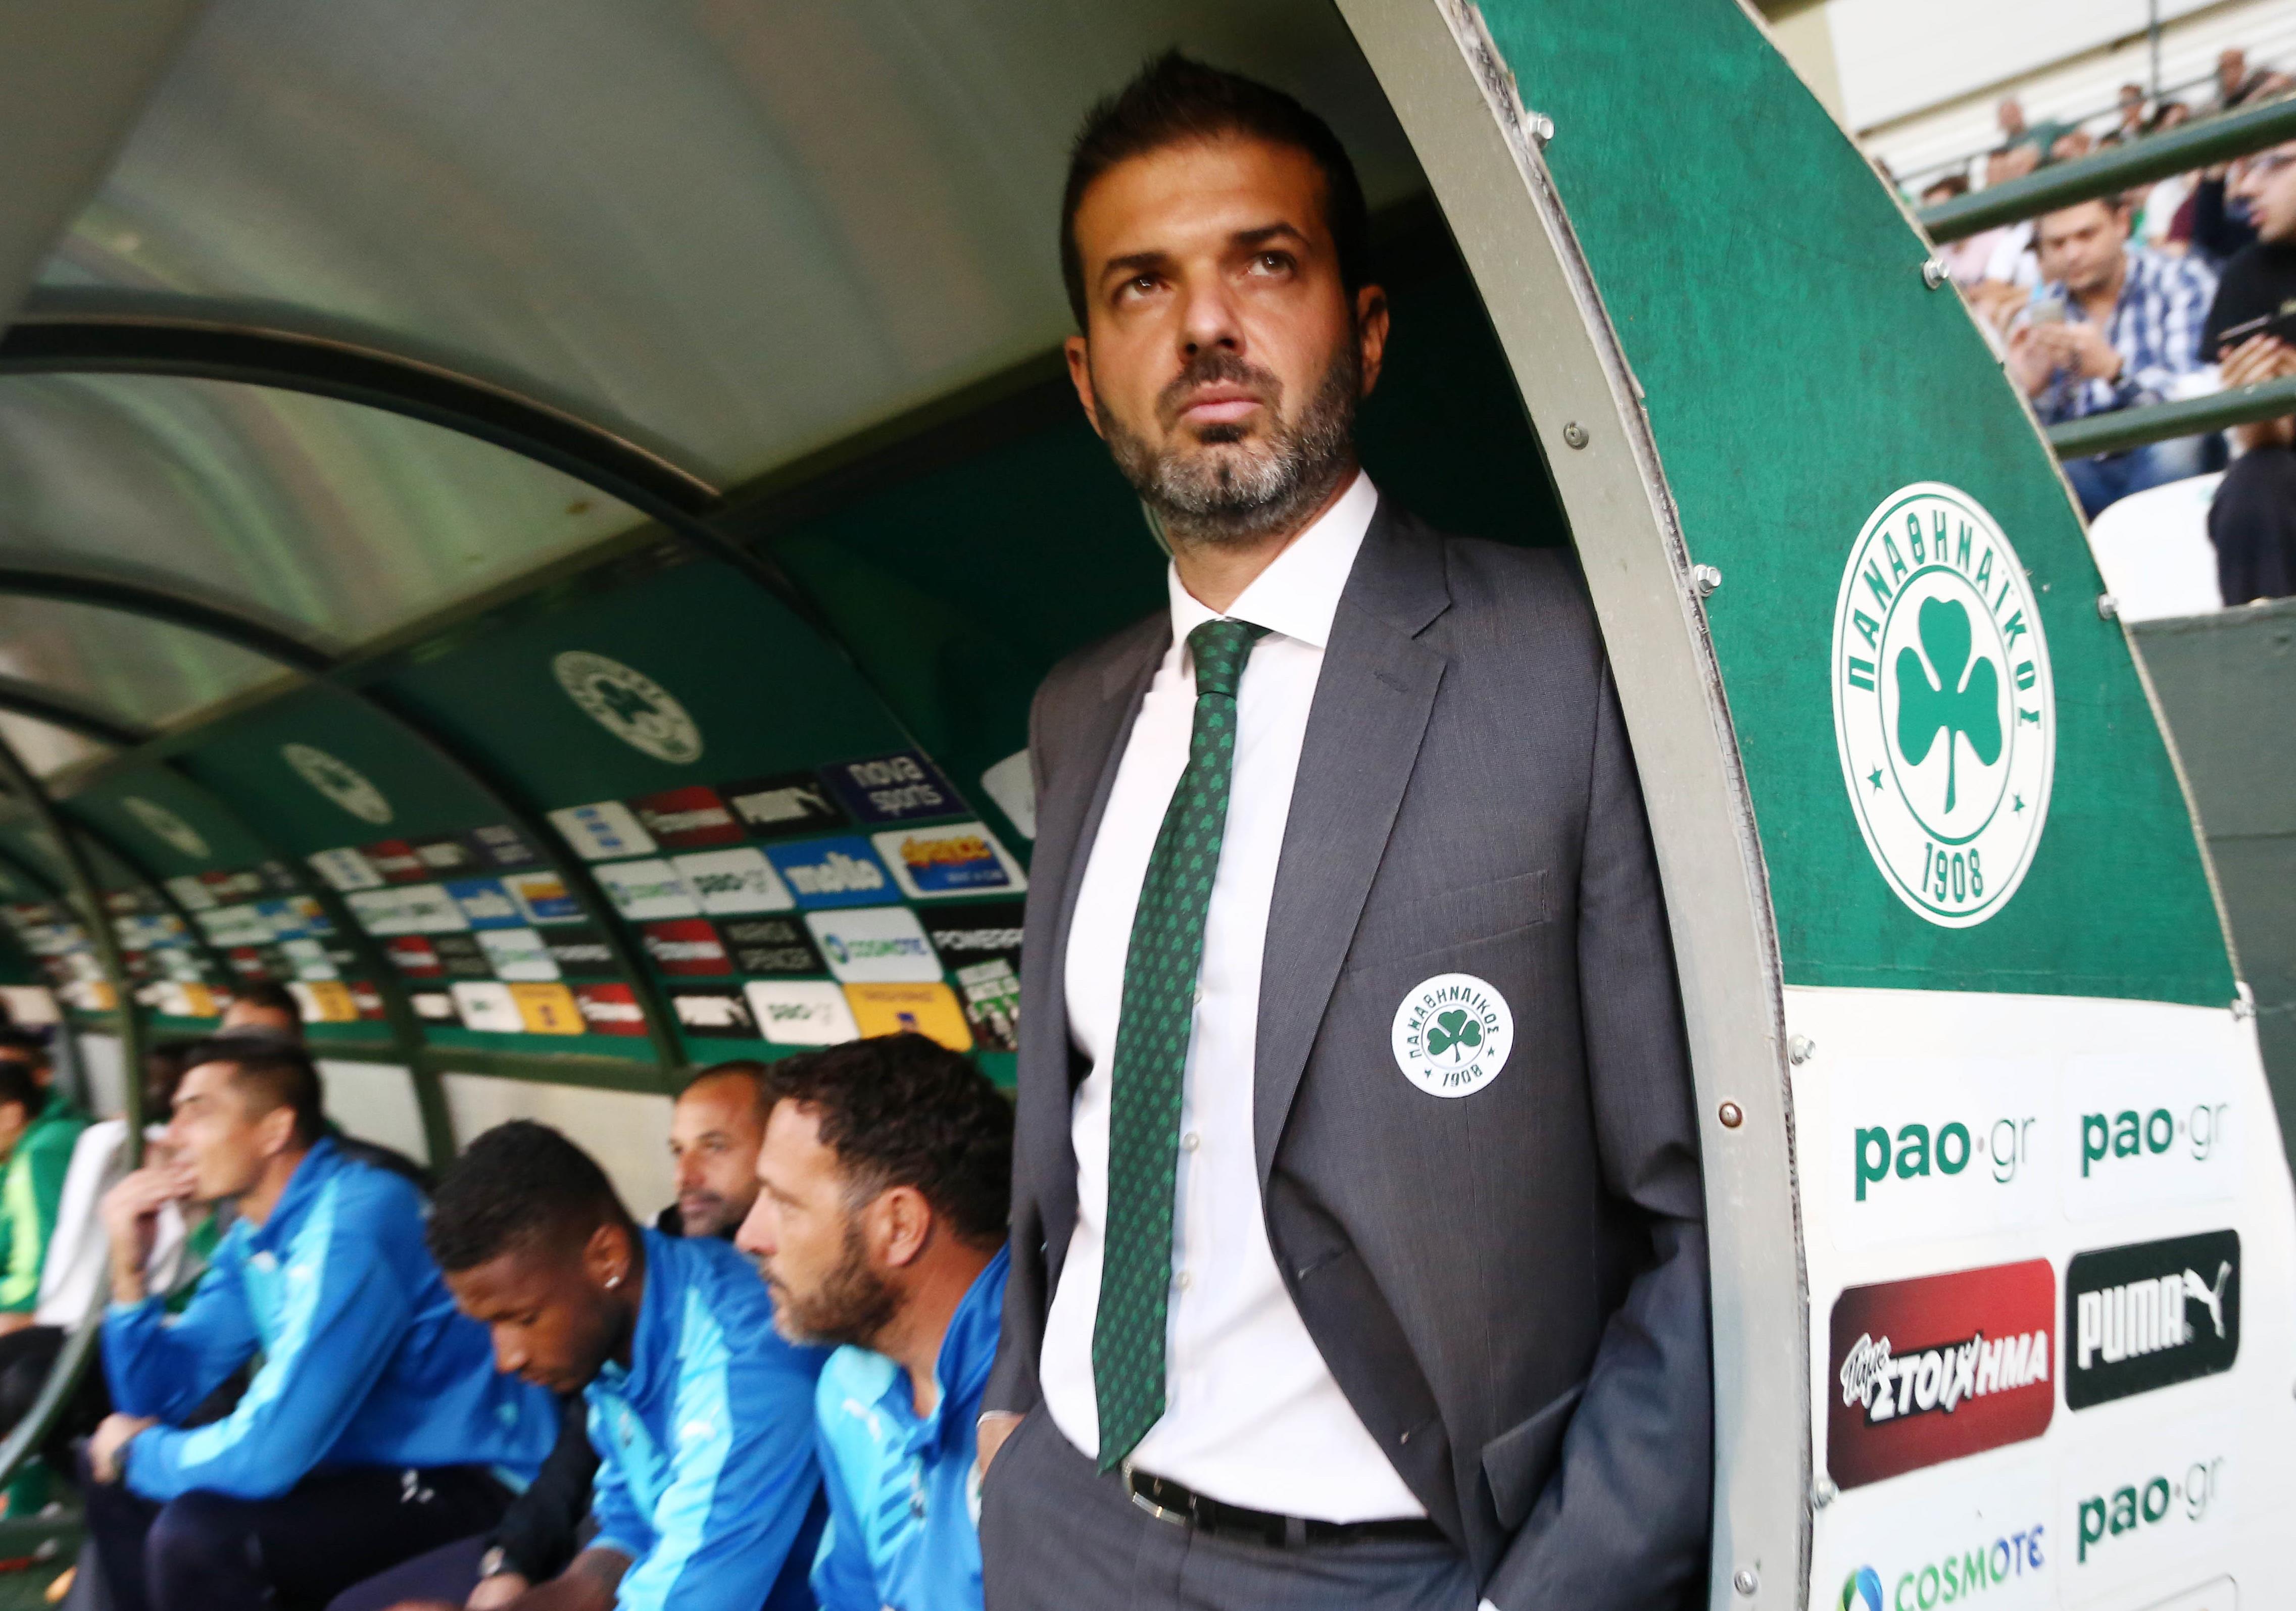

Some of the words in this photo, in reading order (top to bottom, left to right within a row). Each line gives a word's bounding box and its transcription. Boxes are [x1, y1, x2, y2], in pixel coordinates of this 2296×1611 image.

[1921, 842, 1984, 903] 1908
[1443, 1064, 1483, 1087] 1908
[2078, 1274, 2186, 1370] PUMA
[1868, 1330, 2048, 1422] ΣΤΟΙΧΗΜΑ
[1895, 1523, 2044, 1611] COSMOTE
